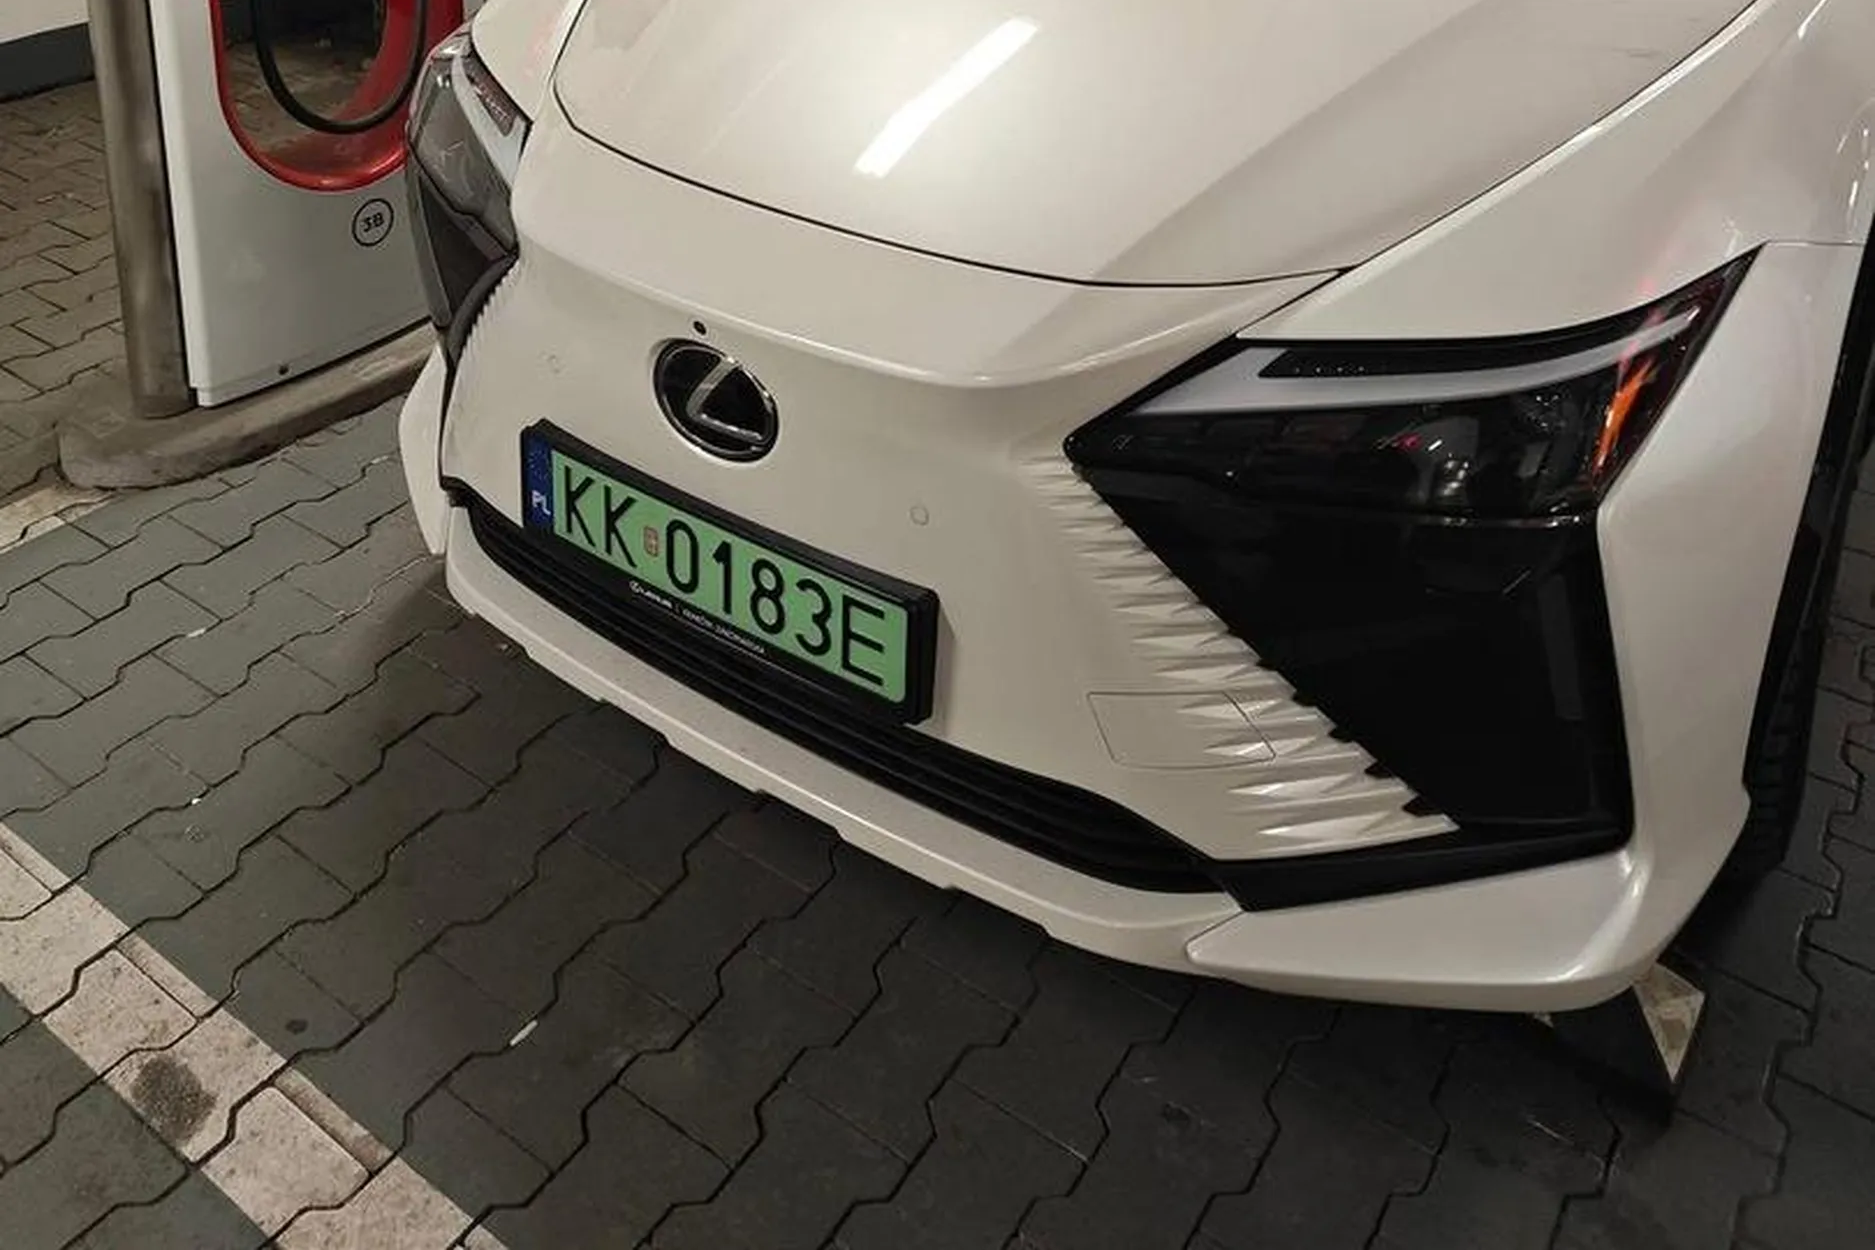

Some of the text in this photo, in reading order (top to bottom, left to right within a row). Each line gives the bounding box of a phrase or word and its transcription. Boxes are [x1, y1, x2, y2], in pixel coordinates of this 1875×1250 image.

[531, 490, 552, 516] PL
[564, 465, 639, 569] KK
[665, 519, 886, 687] 0183E
